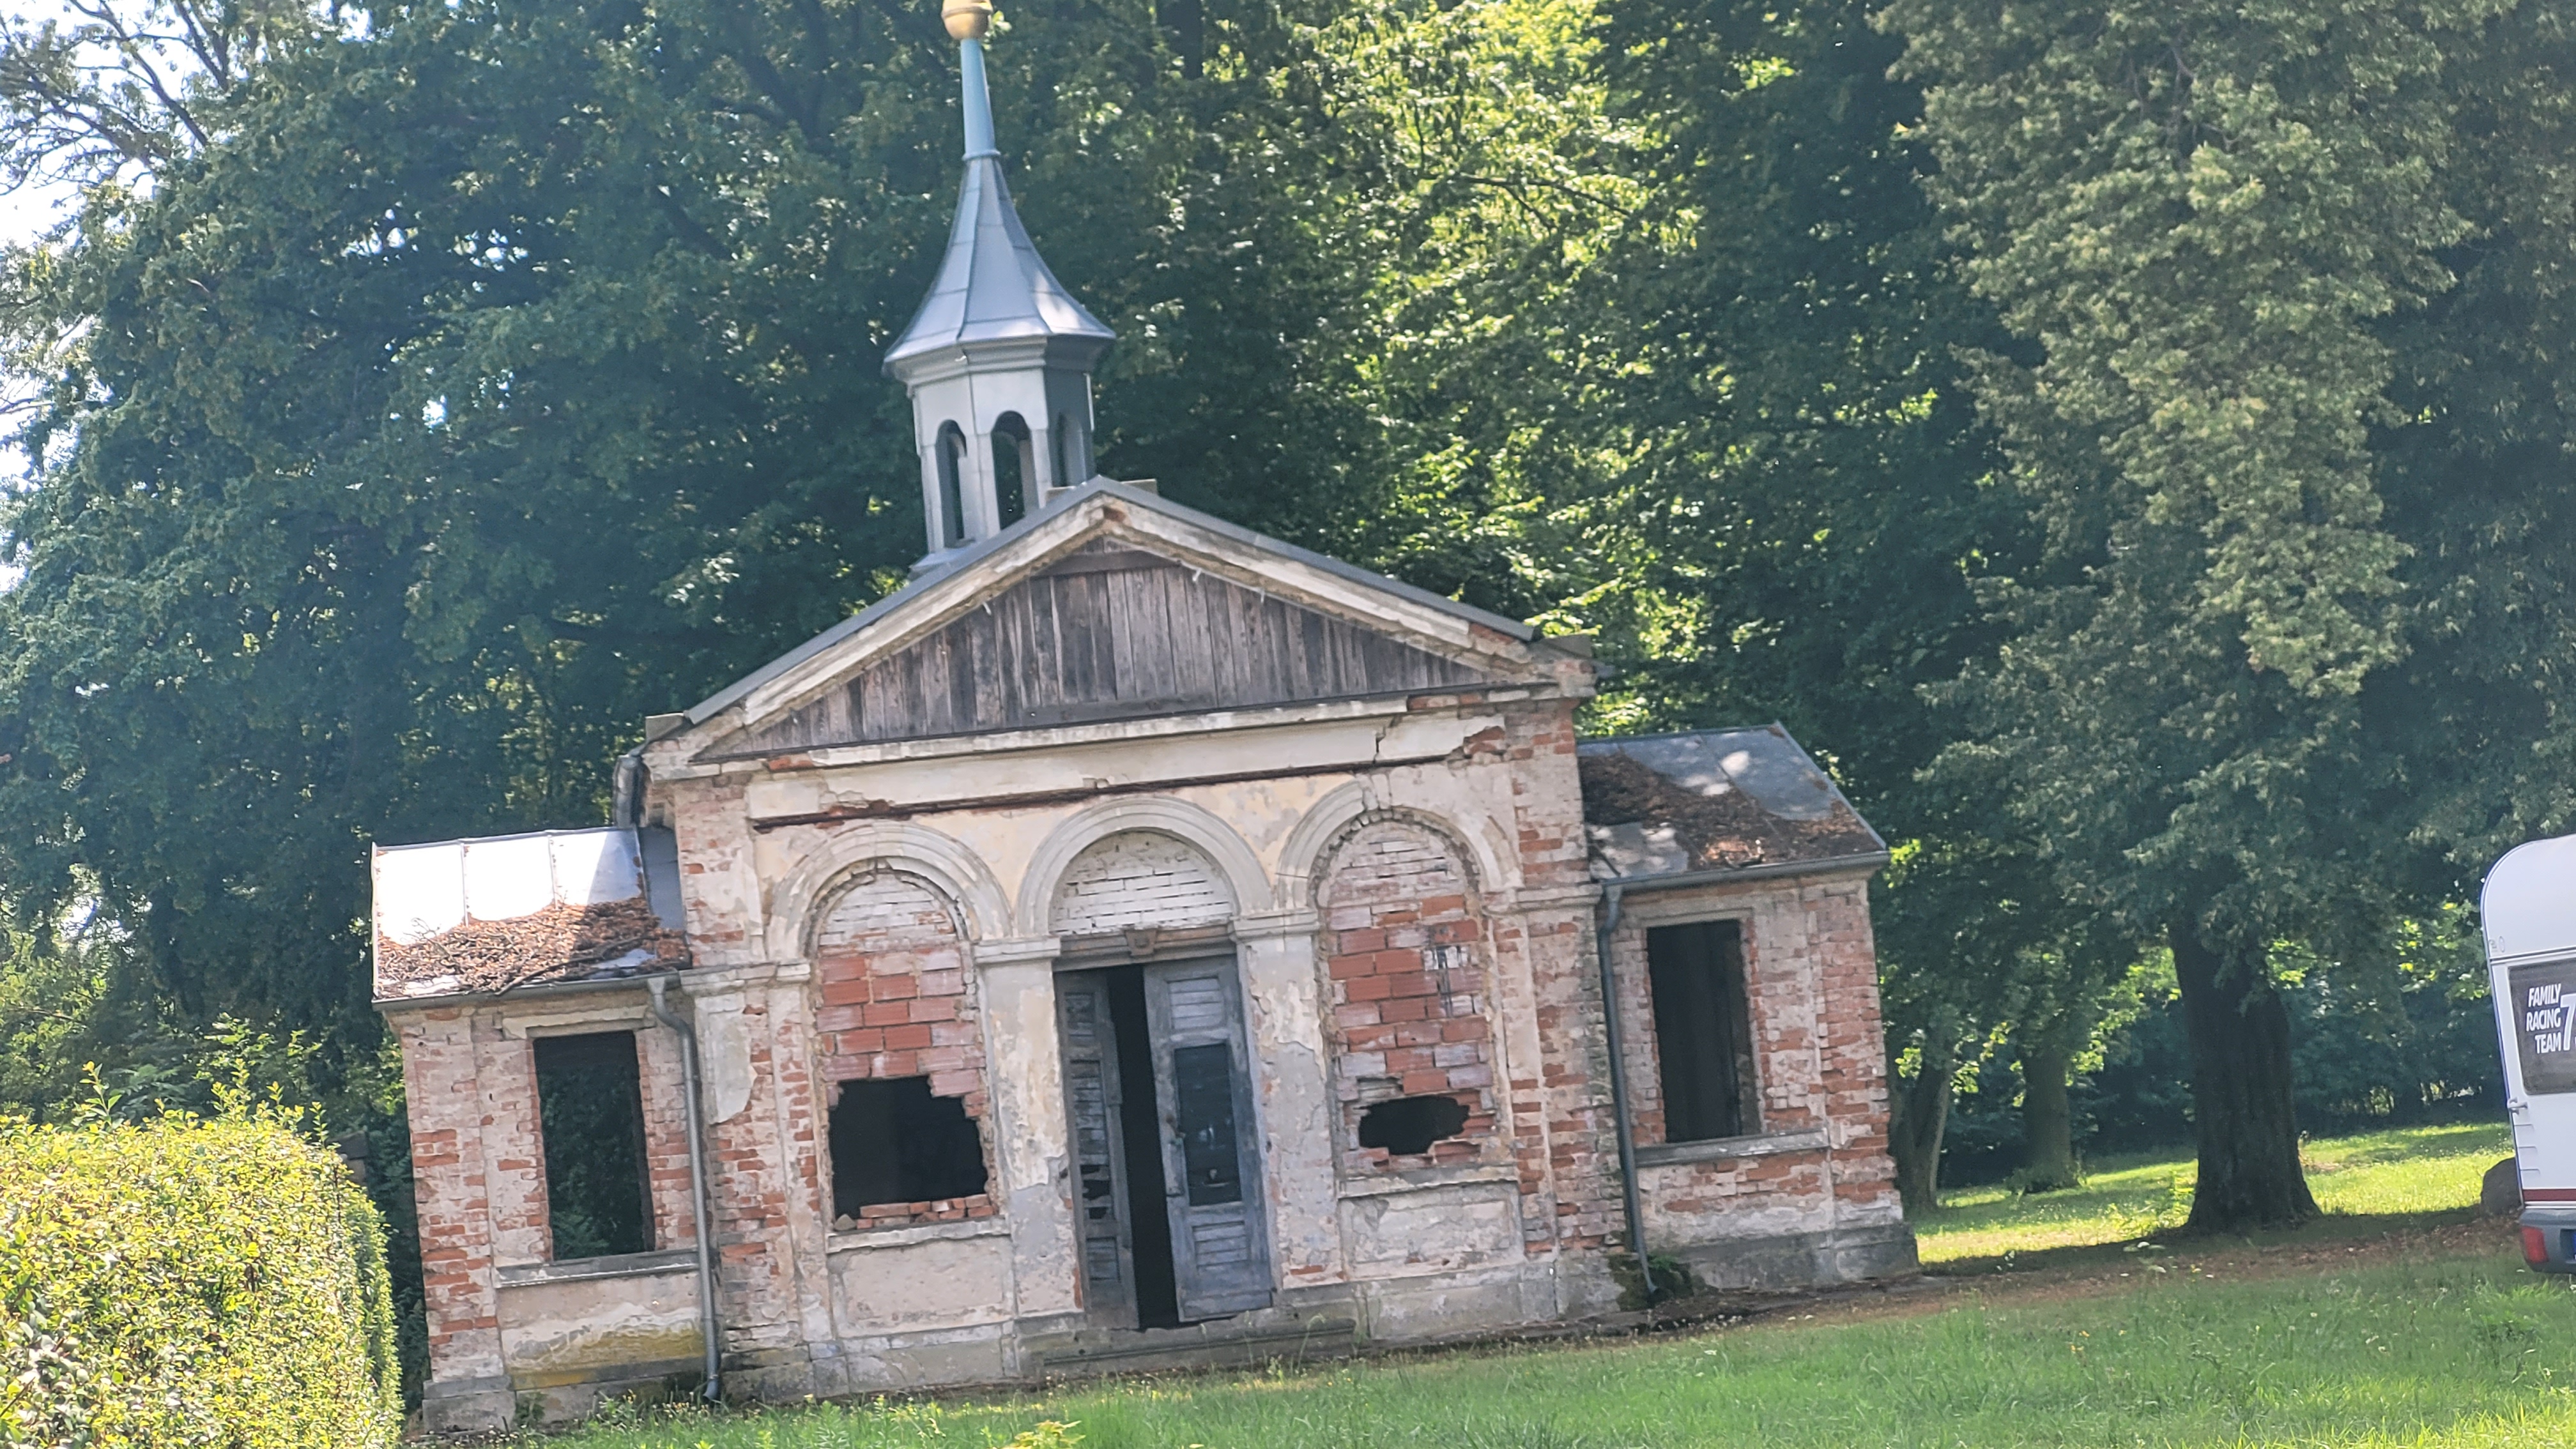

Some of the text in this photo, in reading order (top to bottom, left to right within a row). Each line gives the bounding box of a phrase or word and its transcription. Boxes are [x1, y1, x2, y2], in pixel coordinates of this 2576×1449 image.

[2528, 983, 2561, 1008] FAMILY
[2526, 1008, 2561, 1032] RACING
[2534, 1032, 2561, 1054] TEAM
